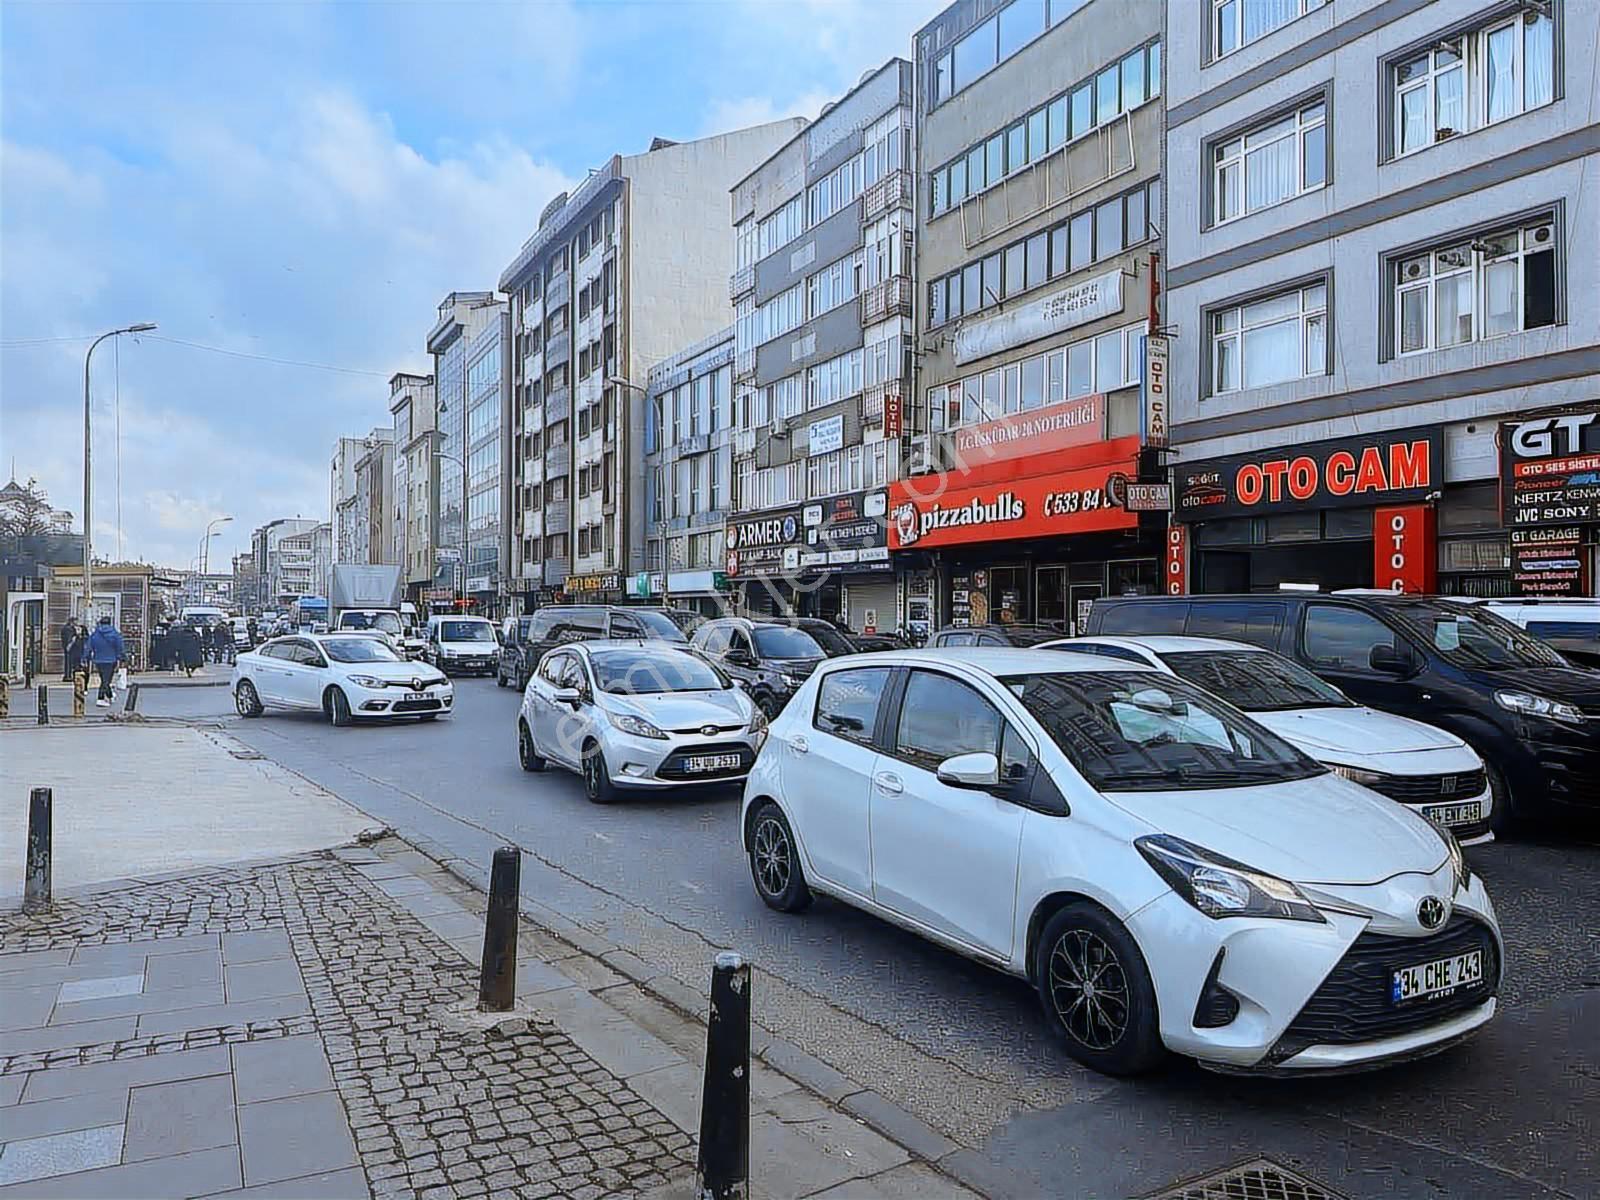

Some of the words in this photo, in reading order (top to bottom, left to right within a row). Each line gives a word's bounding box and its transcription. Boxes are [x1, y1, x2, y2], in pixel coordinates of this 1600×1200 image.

[1151, 361, 1163, 394] OTO
[1151, 402, 1164, 434] CAM
[1512, 412, 1597, 457] GT
[1236, 455, 1319, 505] OTO
[1325, 440, 1430, 496] CAM
[1522, 464, 1543, 475] OTO
[1545, 461, 1566, 473] SES
[1055, 490, 1078, 515] 533
[1082, 488, 1100, 511] 84
[1130, 487, 1147, 500] OTO
[1149, 487, 1168, 501] CAM
[1514, 490, 1563, 505] HERTZ
[920, 492, 1024, 537] pizzabulls
[1515, 508, 1538, 523] JVC
[1543, 506, 1589, 519] SONY
[738, 519, 782, 548] ARMER
[1391, 515, 1405, 569] OTO
[1512, 530, 1527, 542] GT
[1529, 528, 1580, 541] GARAGE
[1170, 530, 1180, 574] OTO
[1401, 969, 1419, 997] 34
[1425, 960, 1452, 990] CHE
[1458, 952, 1480, 982] 243
